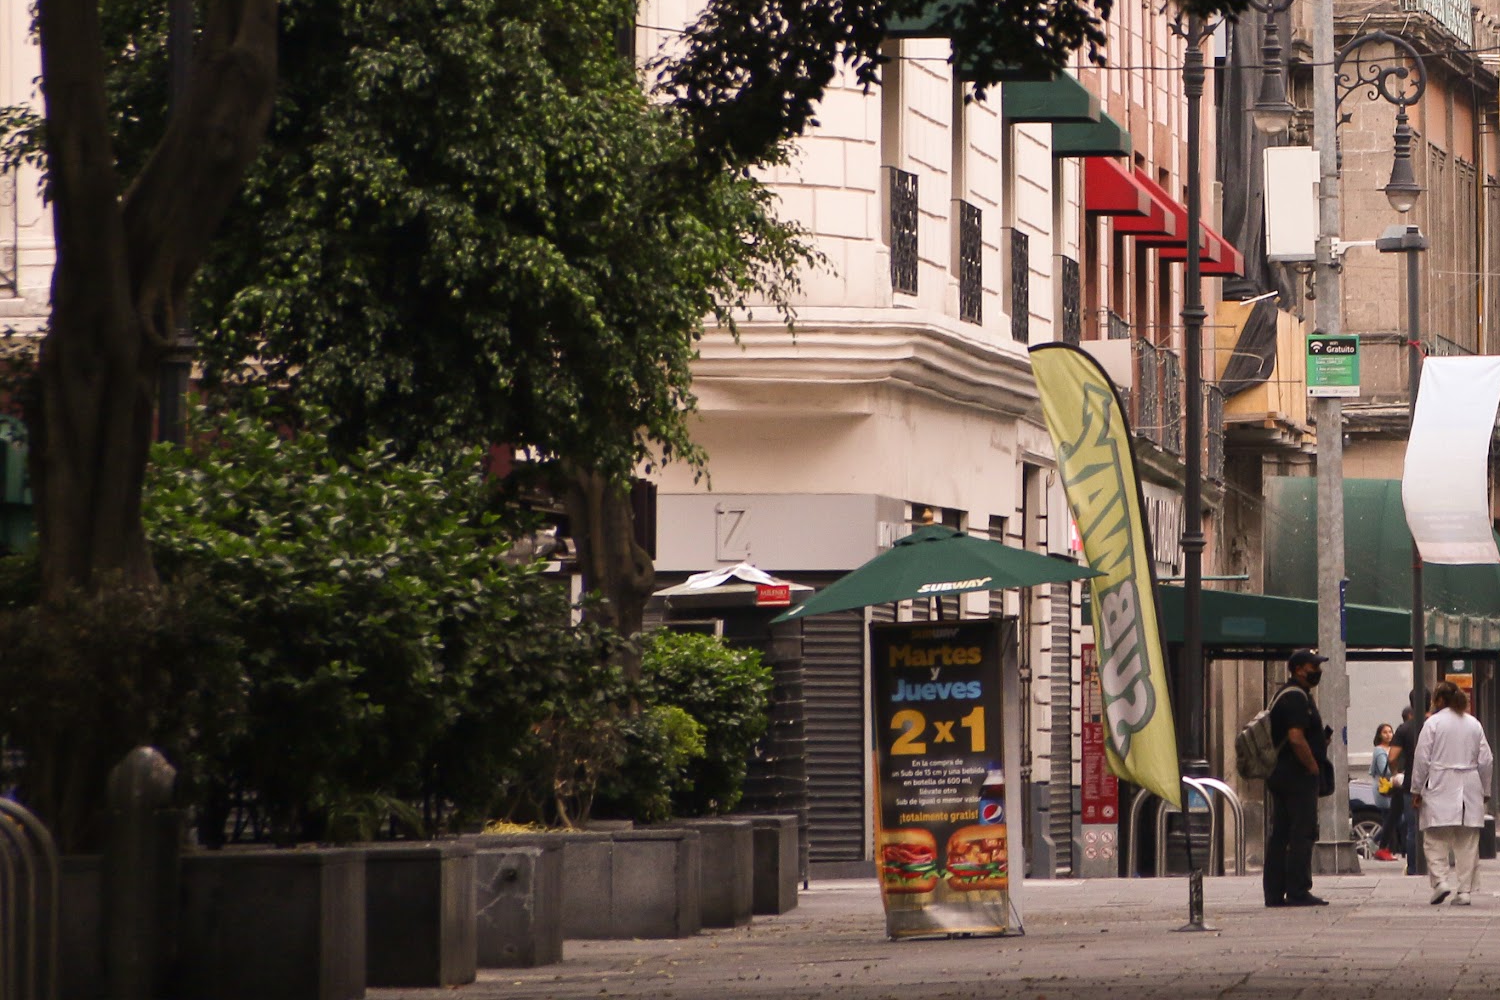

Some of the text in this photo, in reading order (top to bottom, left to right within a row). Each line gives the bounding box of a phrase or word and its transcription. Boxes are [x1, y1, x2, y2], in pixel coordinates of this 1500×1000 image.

[917, 577, 993, 593] SUBWAY
[888, 644, 982, 667] Martes
[930, 667, 941, 681] y
[891, 679, 982, 702] Jueves
[929, 760, 953, 768] compra
[914, 769, 923, 777] de
[919, 797, 936, 807] igual
[950, 809, 979, 823] gratis!
